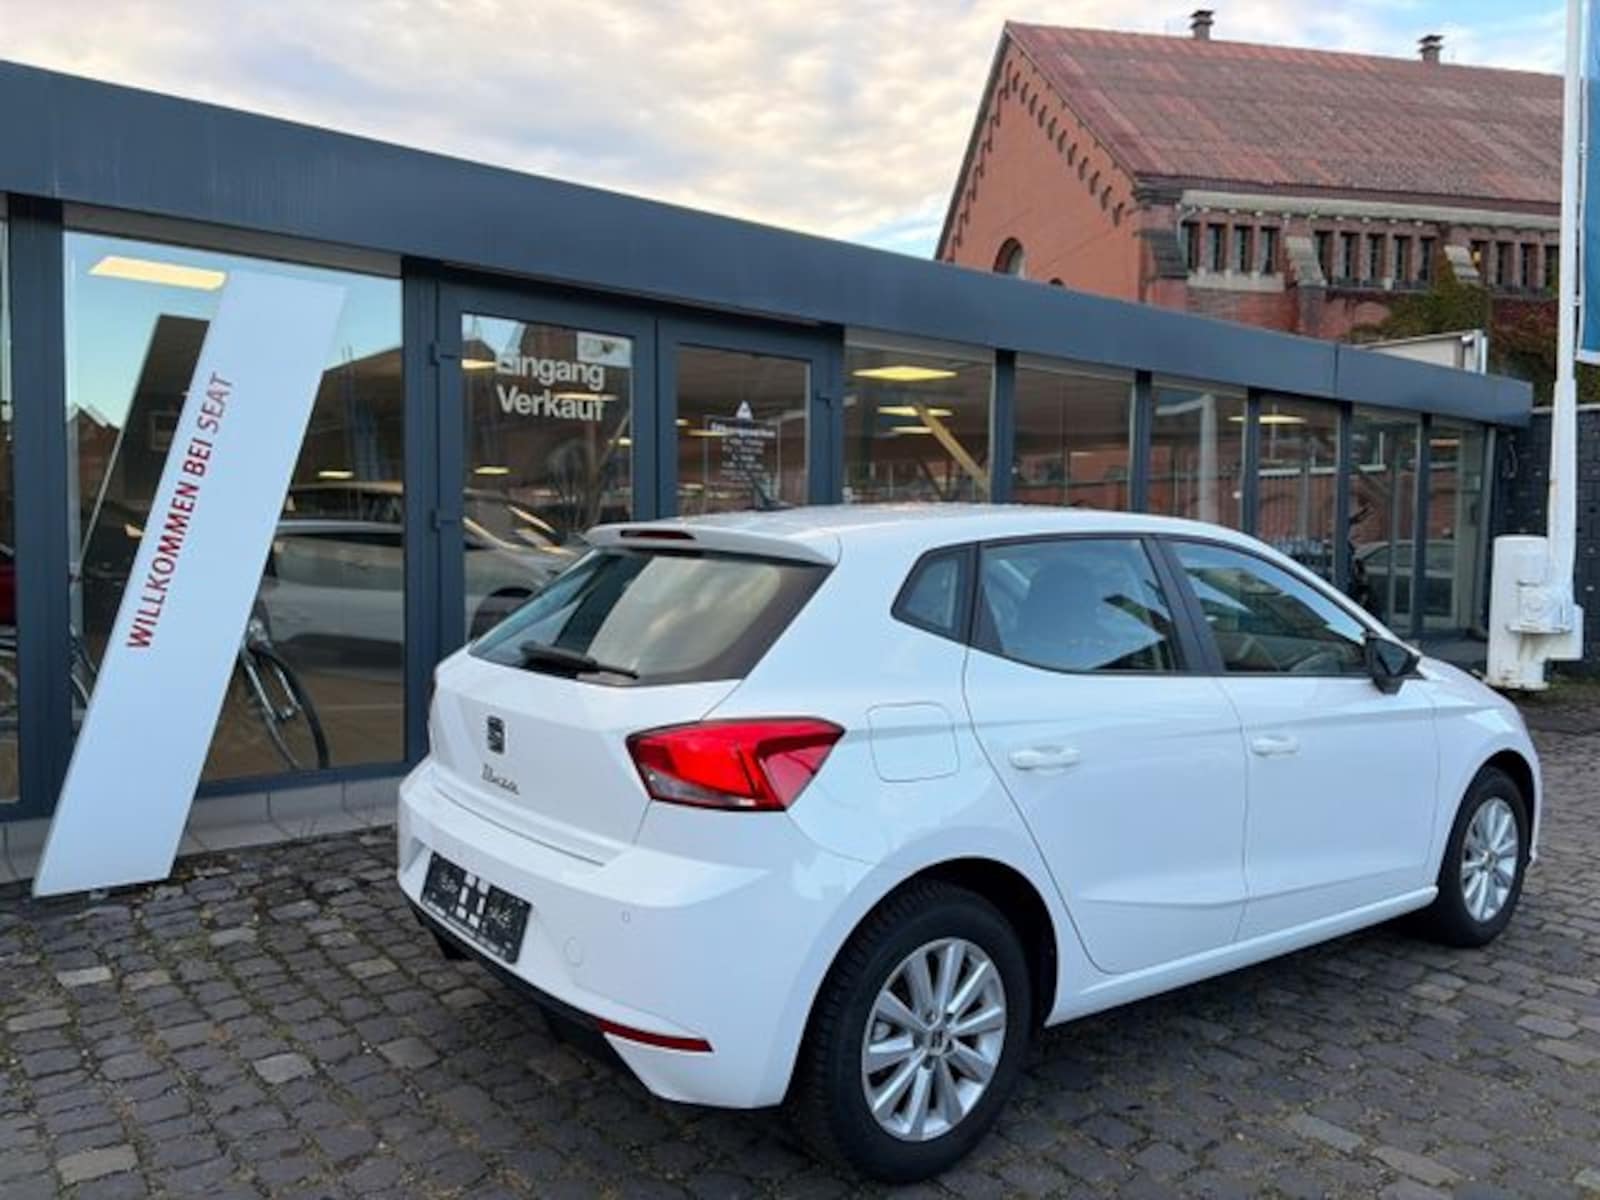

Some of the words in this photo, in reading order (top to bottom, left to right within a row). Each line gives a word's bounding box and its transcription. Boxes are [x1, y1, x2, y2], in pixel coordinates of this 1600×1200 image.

[197, 371, 233, 434] SEAT
[496, 384, 605, 422] Verkauf
[182, 437, 214, 479] BEI
[126, 481, 201, 650] WILLKOMMEN
